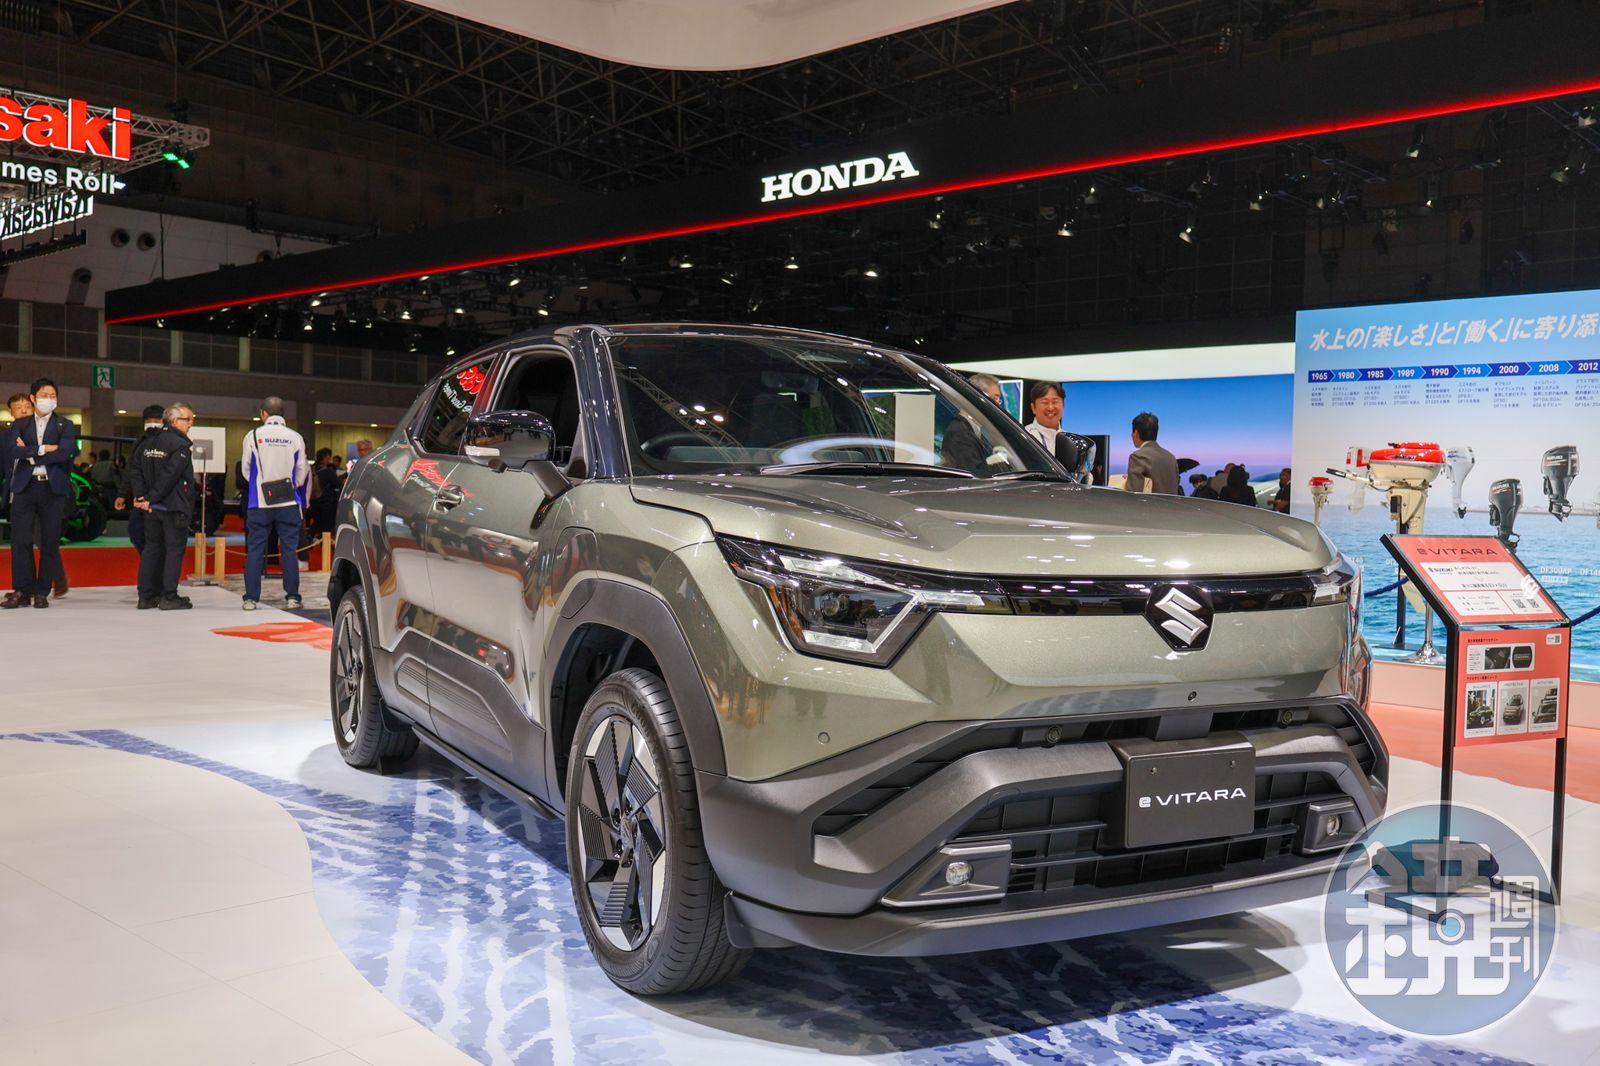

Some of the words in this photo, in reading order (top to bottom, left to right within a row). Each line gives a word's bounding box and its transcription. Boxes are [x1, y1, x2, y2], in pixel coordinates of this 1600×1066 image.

[2, 161, 57, 186] mes
[761, 151, 919, 203] HONDA
[1311, 372, 1328, 380] 1965
[1338, 371, 1355, 379] 1980
[1367, 370, 1384, 378] 1985
[1397, 369, 1415, 377] 1989
[1431, 368, 1449, 376] 1990
[1463, 366, 1481, 375] 1994
[1499, 365, 1519, 374] 2000
[1538, 364, 1559, 372] 2008
[1578, 362, 1598, 371] 2012
[1428, 548, 1498, 556] VITARA
[1156, 787, 1247, 806] VITARA
